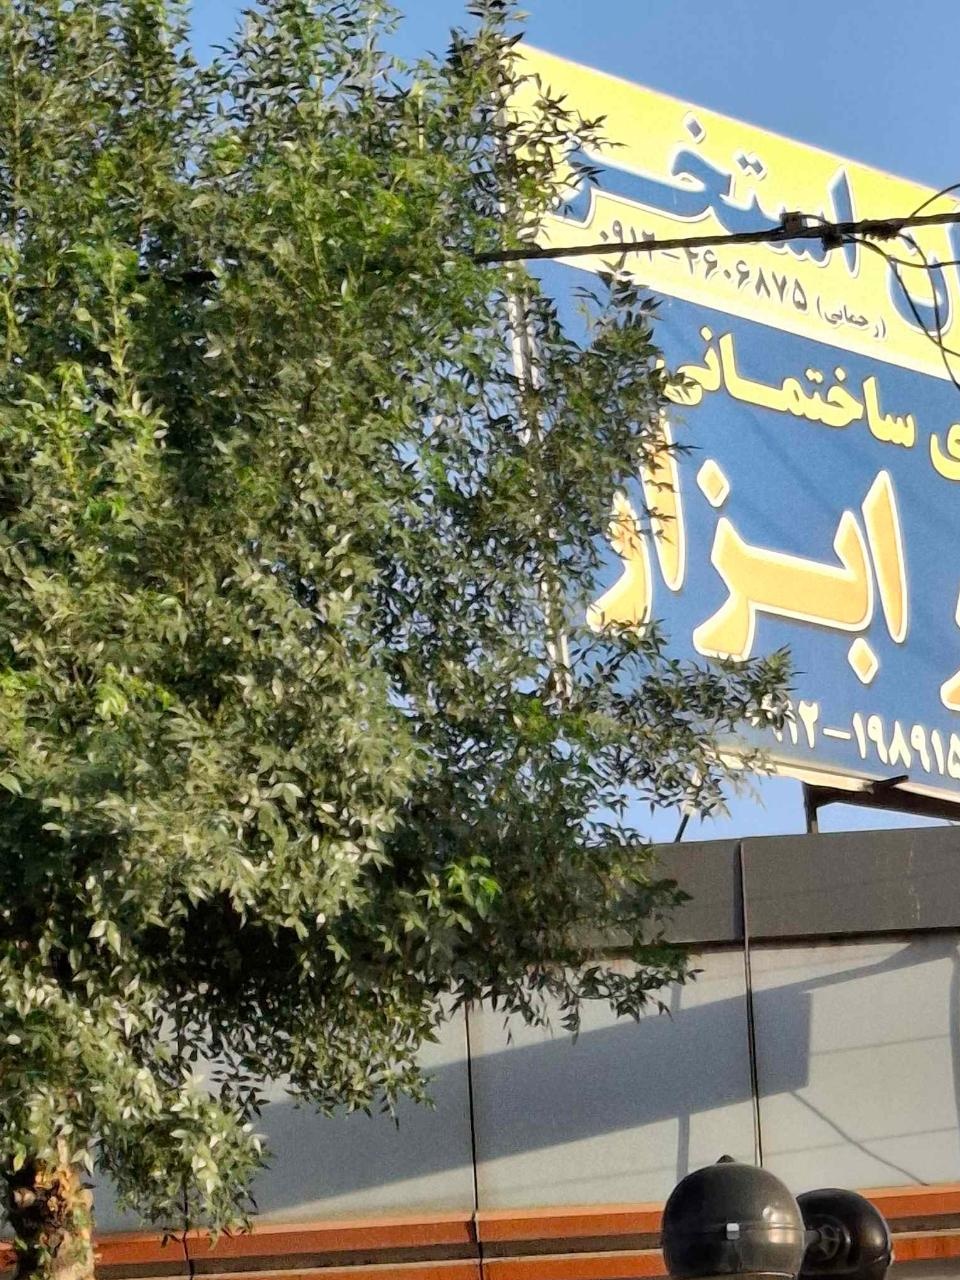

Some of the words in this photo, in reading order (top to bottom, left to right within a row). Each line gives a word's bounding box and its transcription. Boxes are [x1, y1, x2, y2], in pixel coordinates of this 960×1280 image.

[550, 108, 860, 280] استخر
[655, 326, 916, 448] ساختمانی
[586, 408, 908, 684] ابزار
